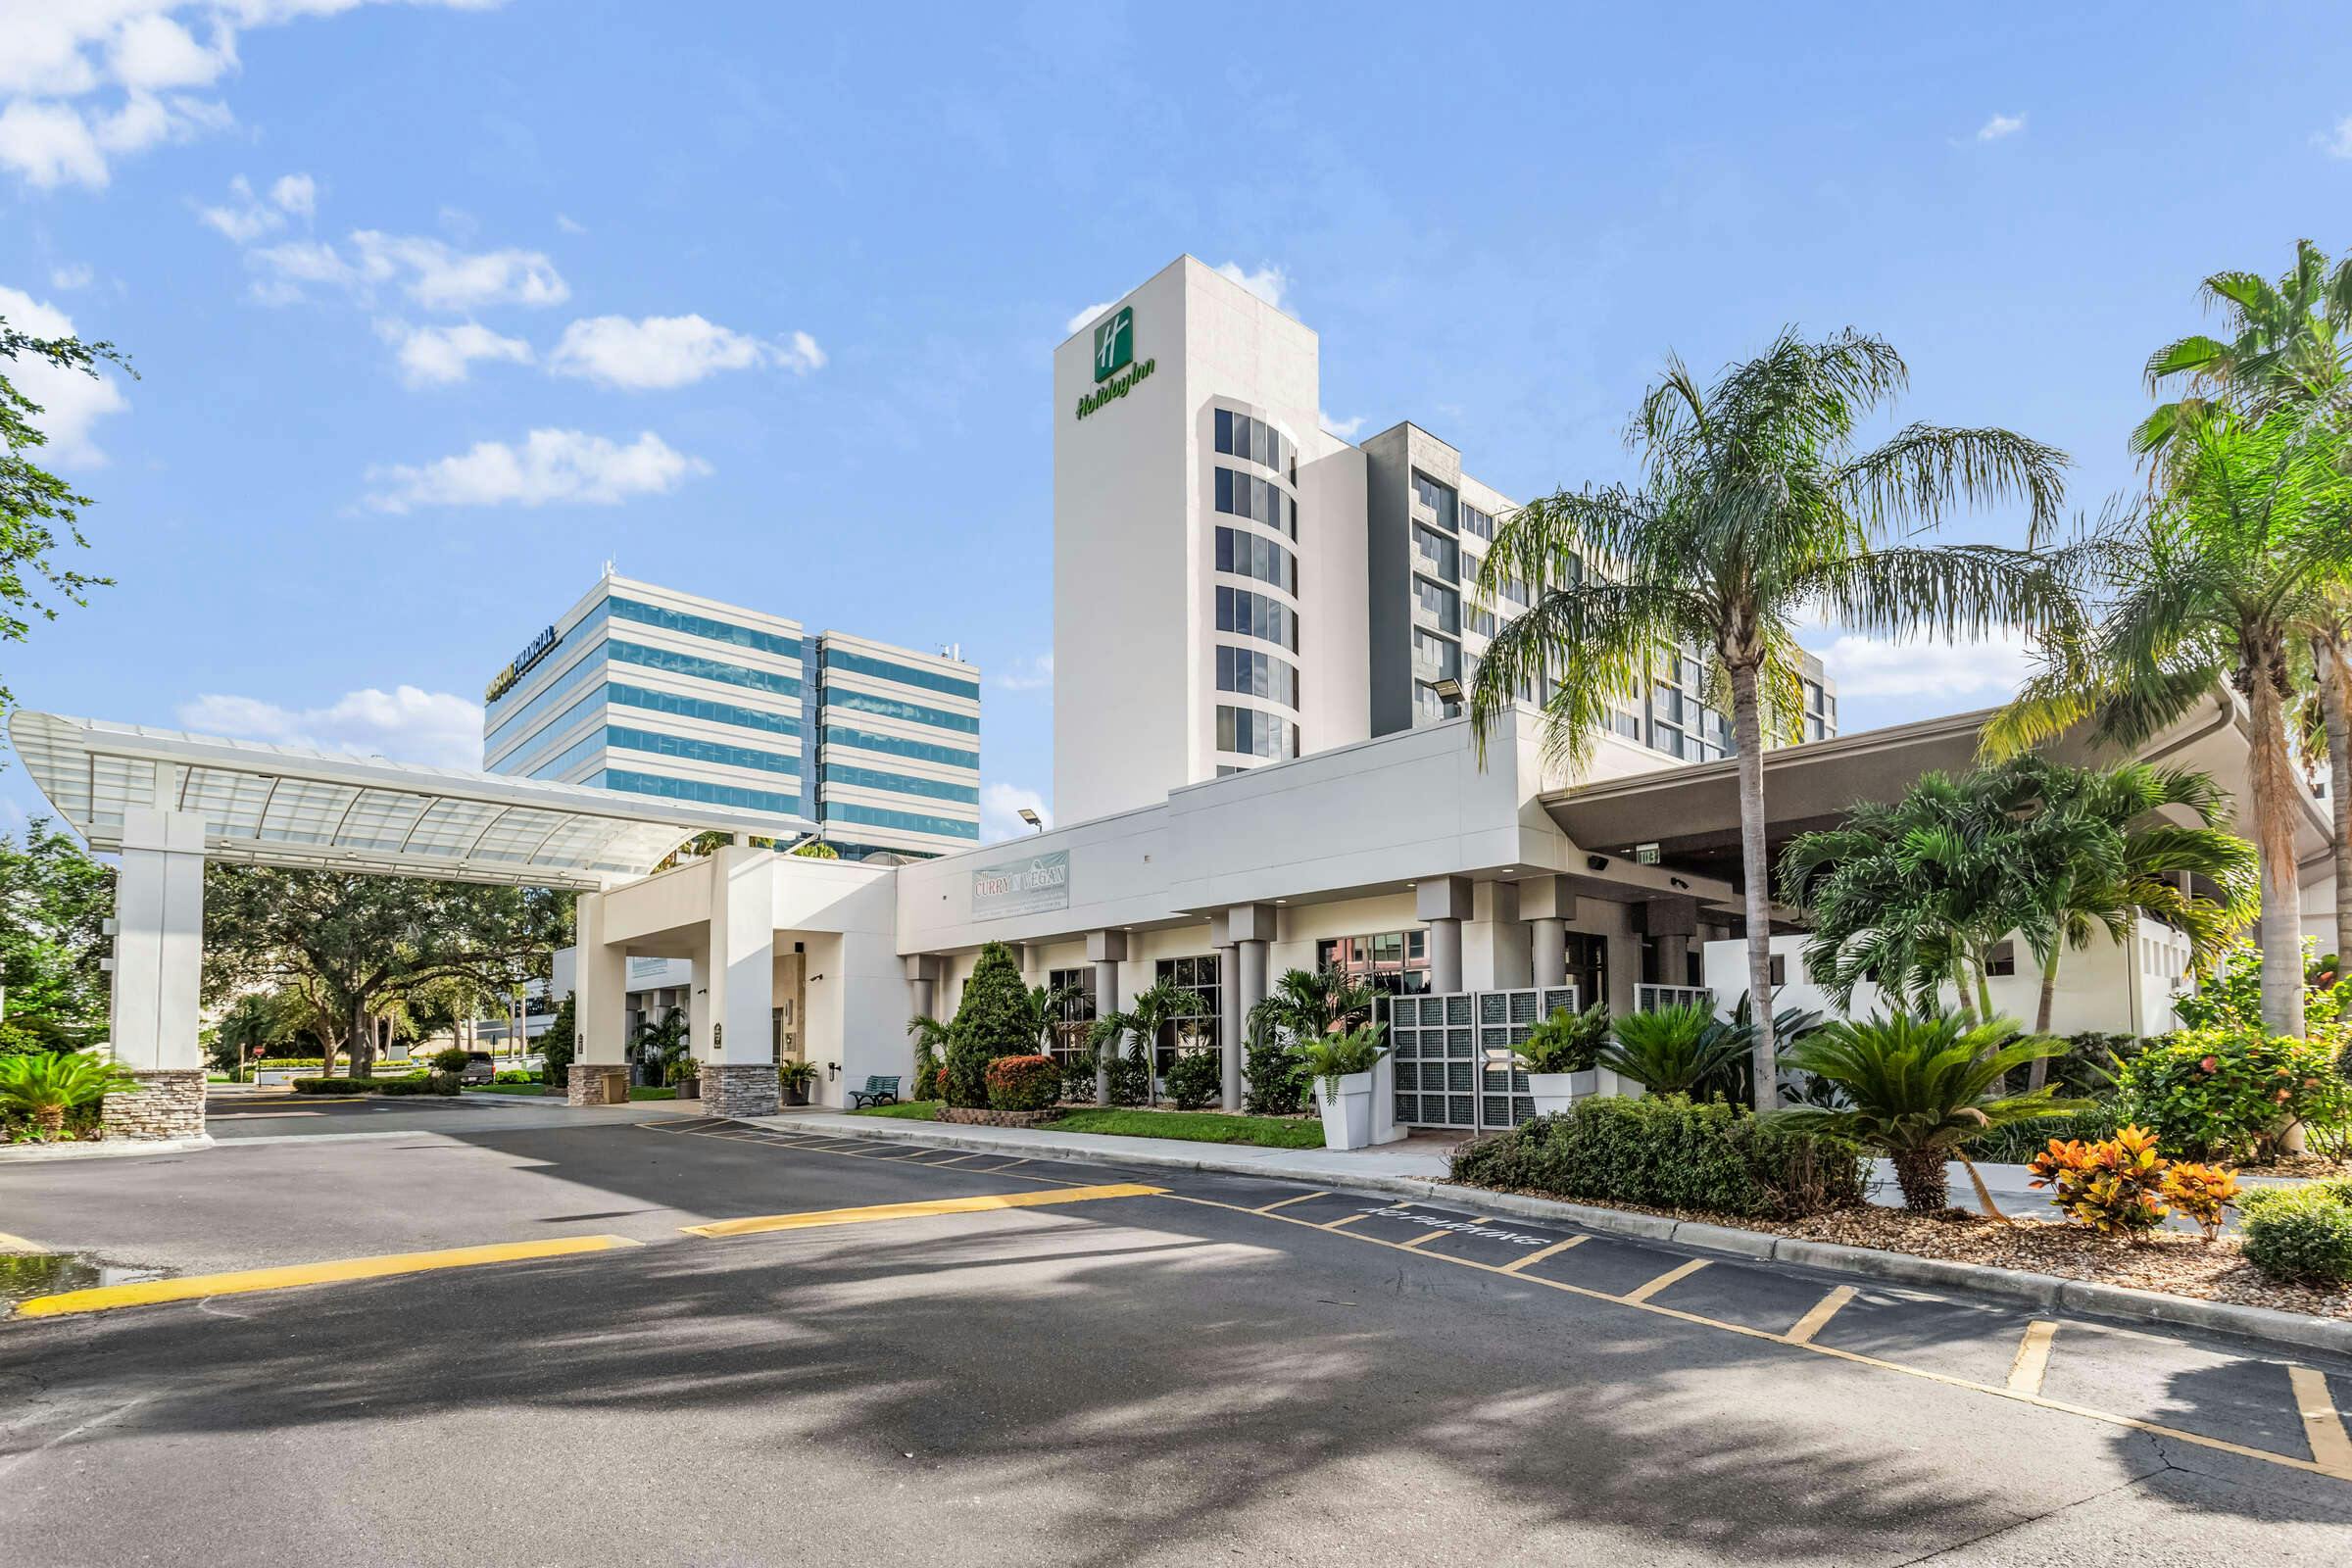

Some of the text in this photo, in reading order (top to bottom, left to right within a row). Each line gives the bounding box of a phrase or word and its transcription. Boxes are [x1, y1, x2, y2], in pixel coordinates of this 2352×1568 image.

[1075, 358, 1155, 420] Holiday Inn
[1023, 864, 1066, 890] VEGAN
[1396, 1215, 1551, 1245] PARKING
